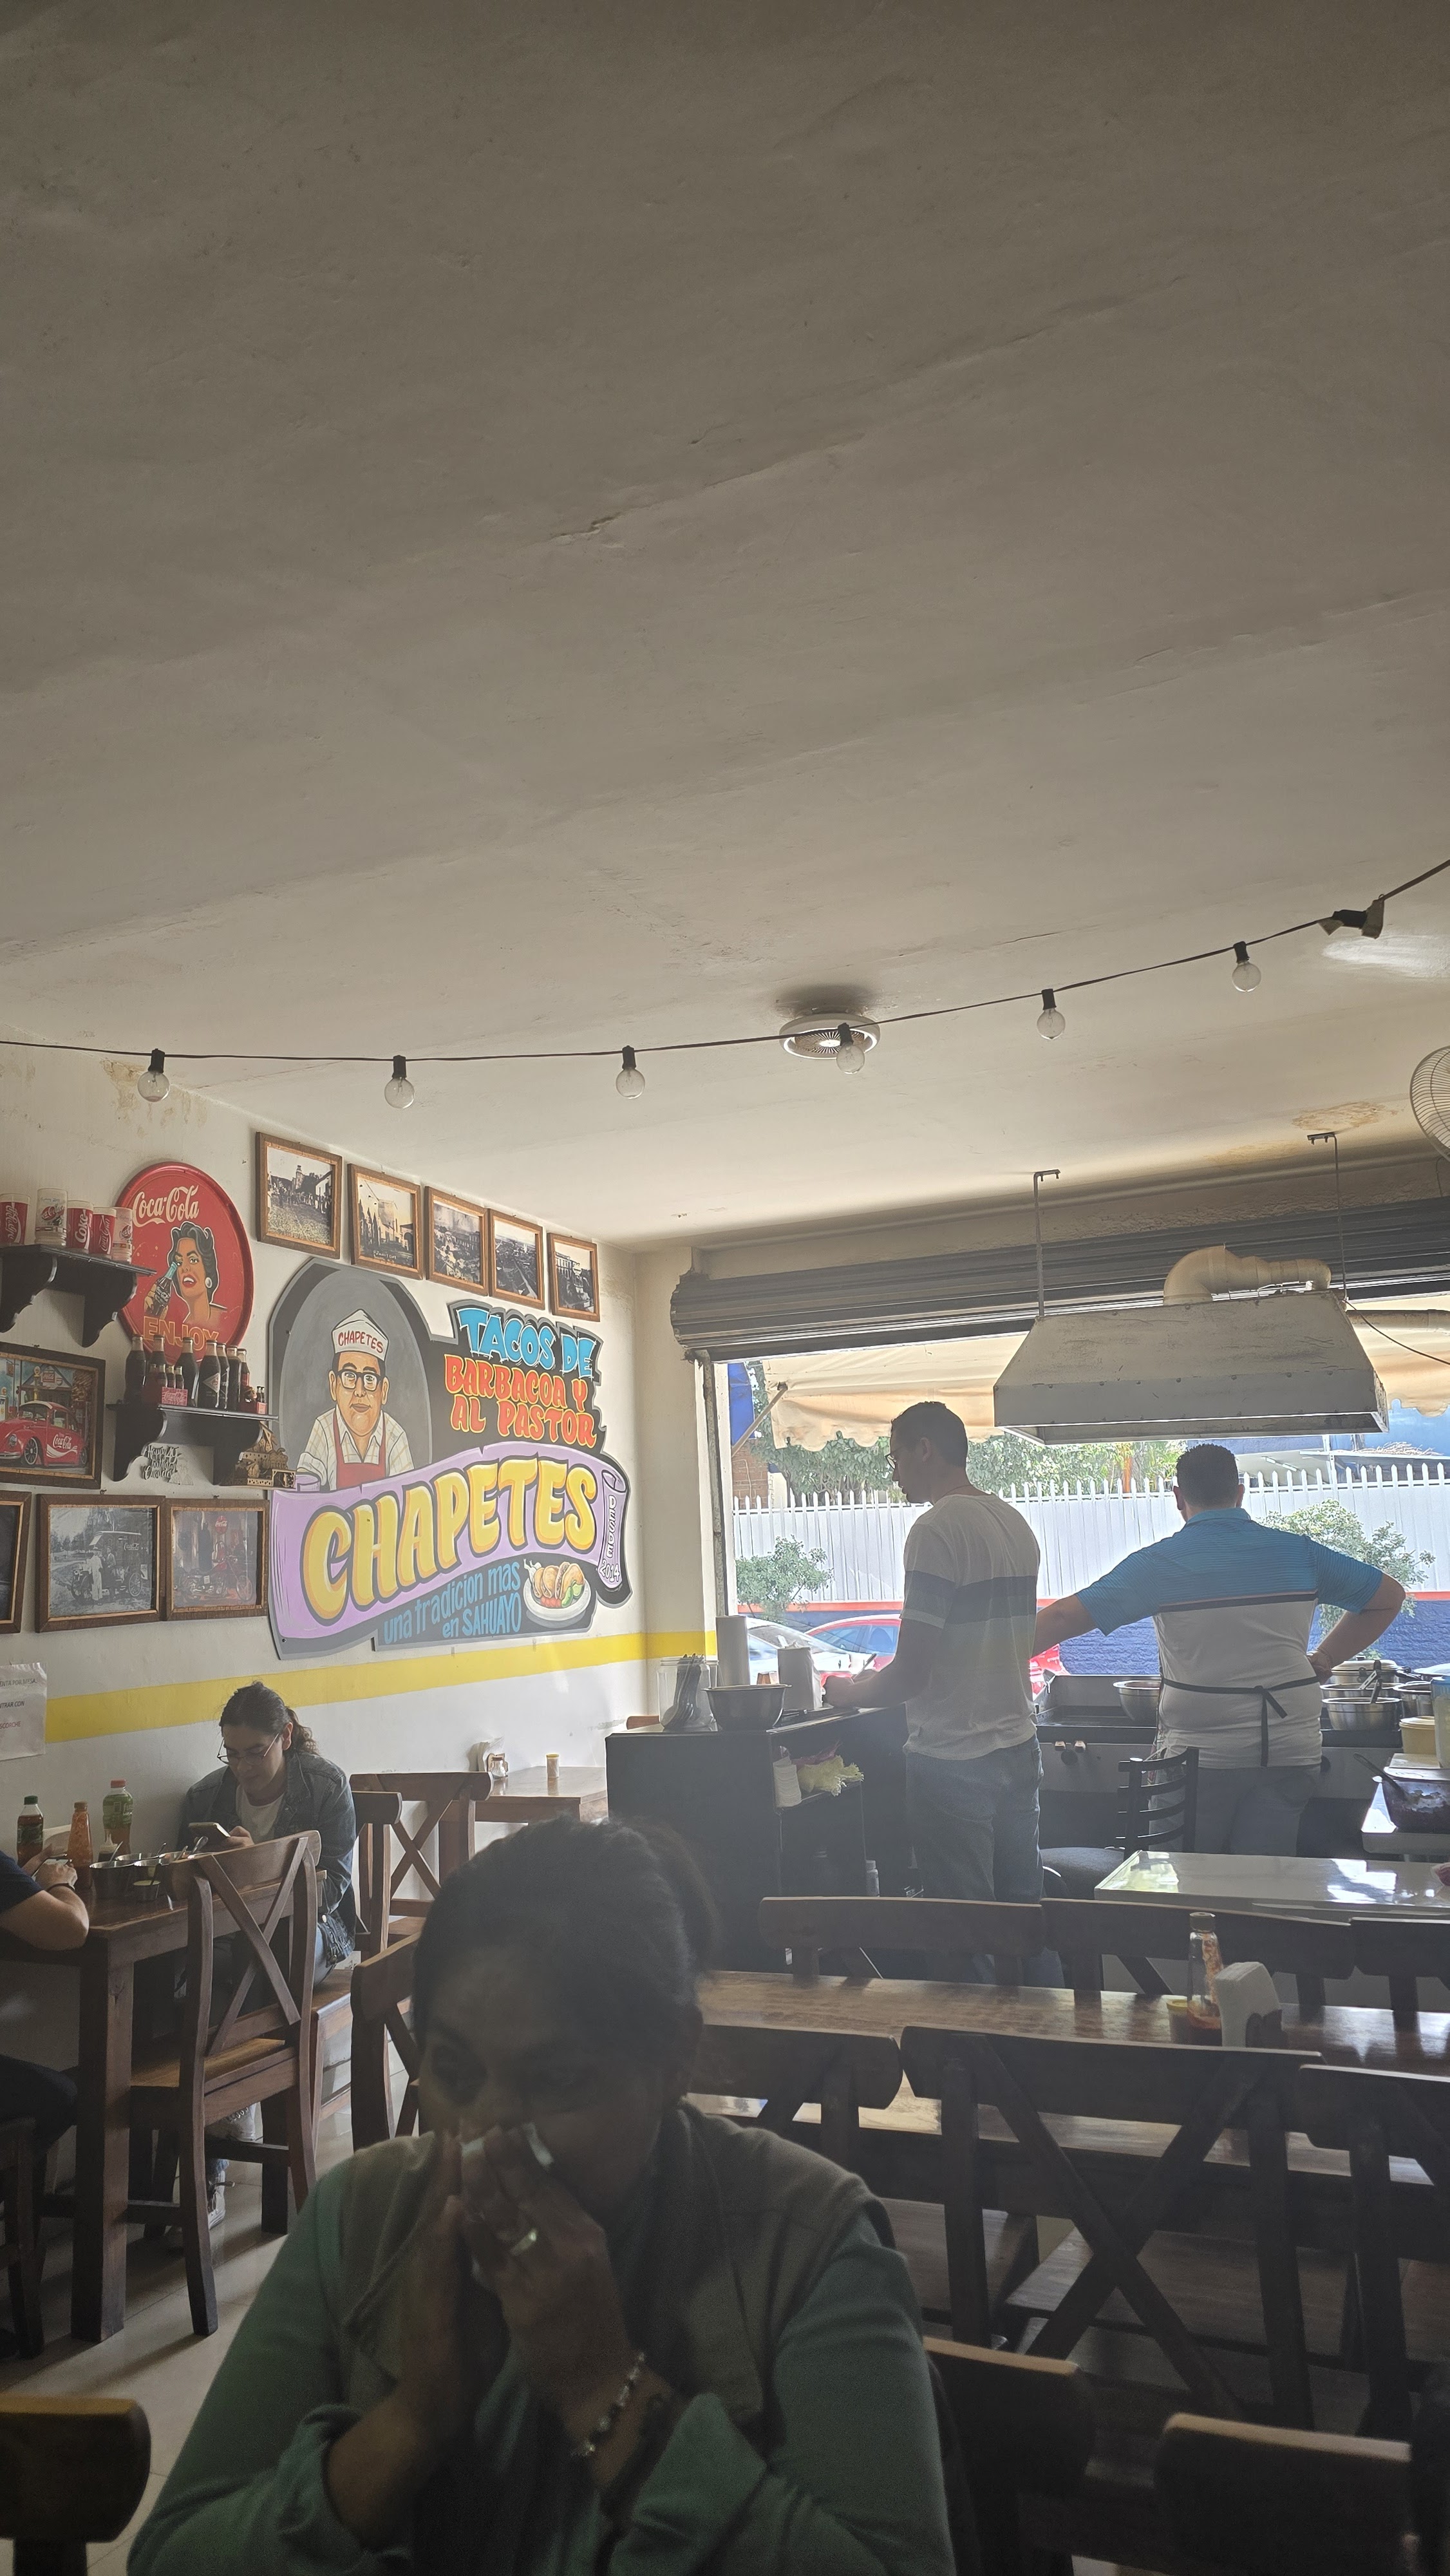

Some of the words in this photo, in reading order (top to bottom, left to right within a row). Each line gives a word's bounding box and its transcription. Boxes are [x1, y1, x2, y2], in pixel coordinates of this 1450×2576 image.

[75, 1213, 89, 1244] Coke
[132, 1185, 199, 1227] Coca-Cola
[144, 1316, 219, 1351] ENJOY
[338, 1330, 384, 1353] CHAPETES
[457, 1308, 556, 1370] TACOS
[560, 1333, 597, 1379] DE
[444, 1354, 568, 1410] BARBACOA
[571, 1378, 588, 1412] Y
[451, 1394, 486, 1433] AL
[496, 1400, 598, 1448] PASTOR
[302, 1457, 598, 1620] CHAPETES
[607, 1495, 617, 1558] DESDE
[599, 1559, 620, 1582] 2014
[384, 1609, 413, 1644] una
[415, 1572, 483, 1634] tradicion
[488, 1562, 521, 1596] mas
[442, 1617, 459, 1638] en
[462, 1592, 522, 1636] SAHUAYO
